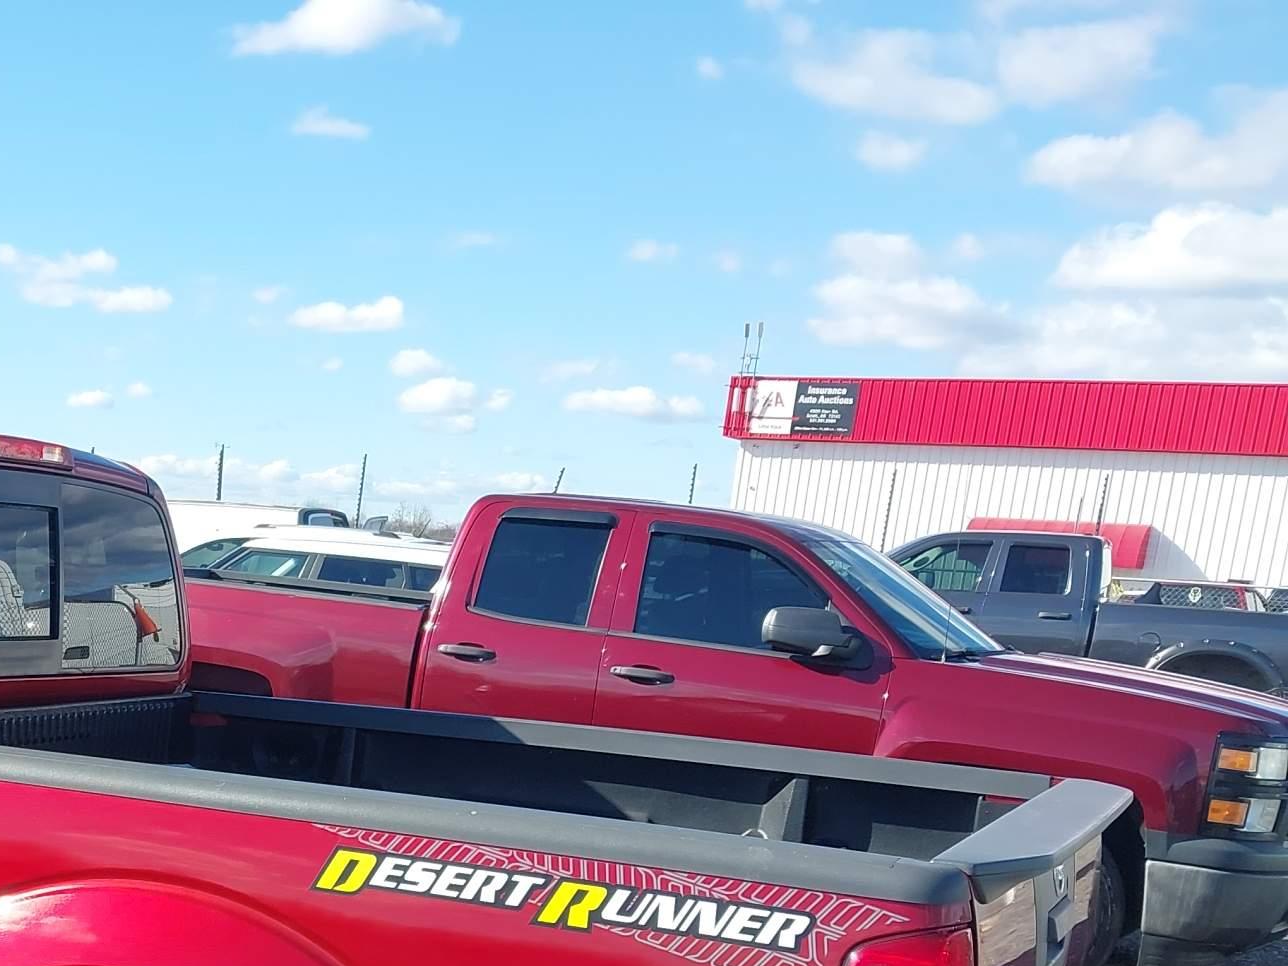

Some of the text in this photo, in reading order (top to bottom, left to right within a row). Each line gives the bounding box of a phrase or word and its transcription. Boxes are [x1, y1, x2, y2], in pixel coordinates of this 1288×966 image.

[807, 385, 848, 395] Insurance
[798, 395, 854, 405] Auto Auctions
[314, 848, 813, 948] DESERT RUNNER
